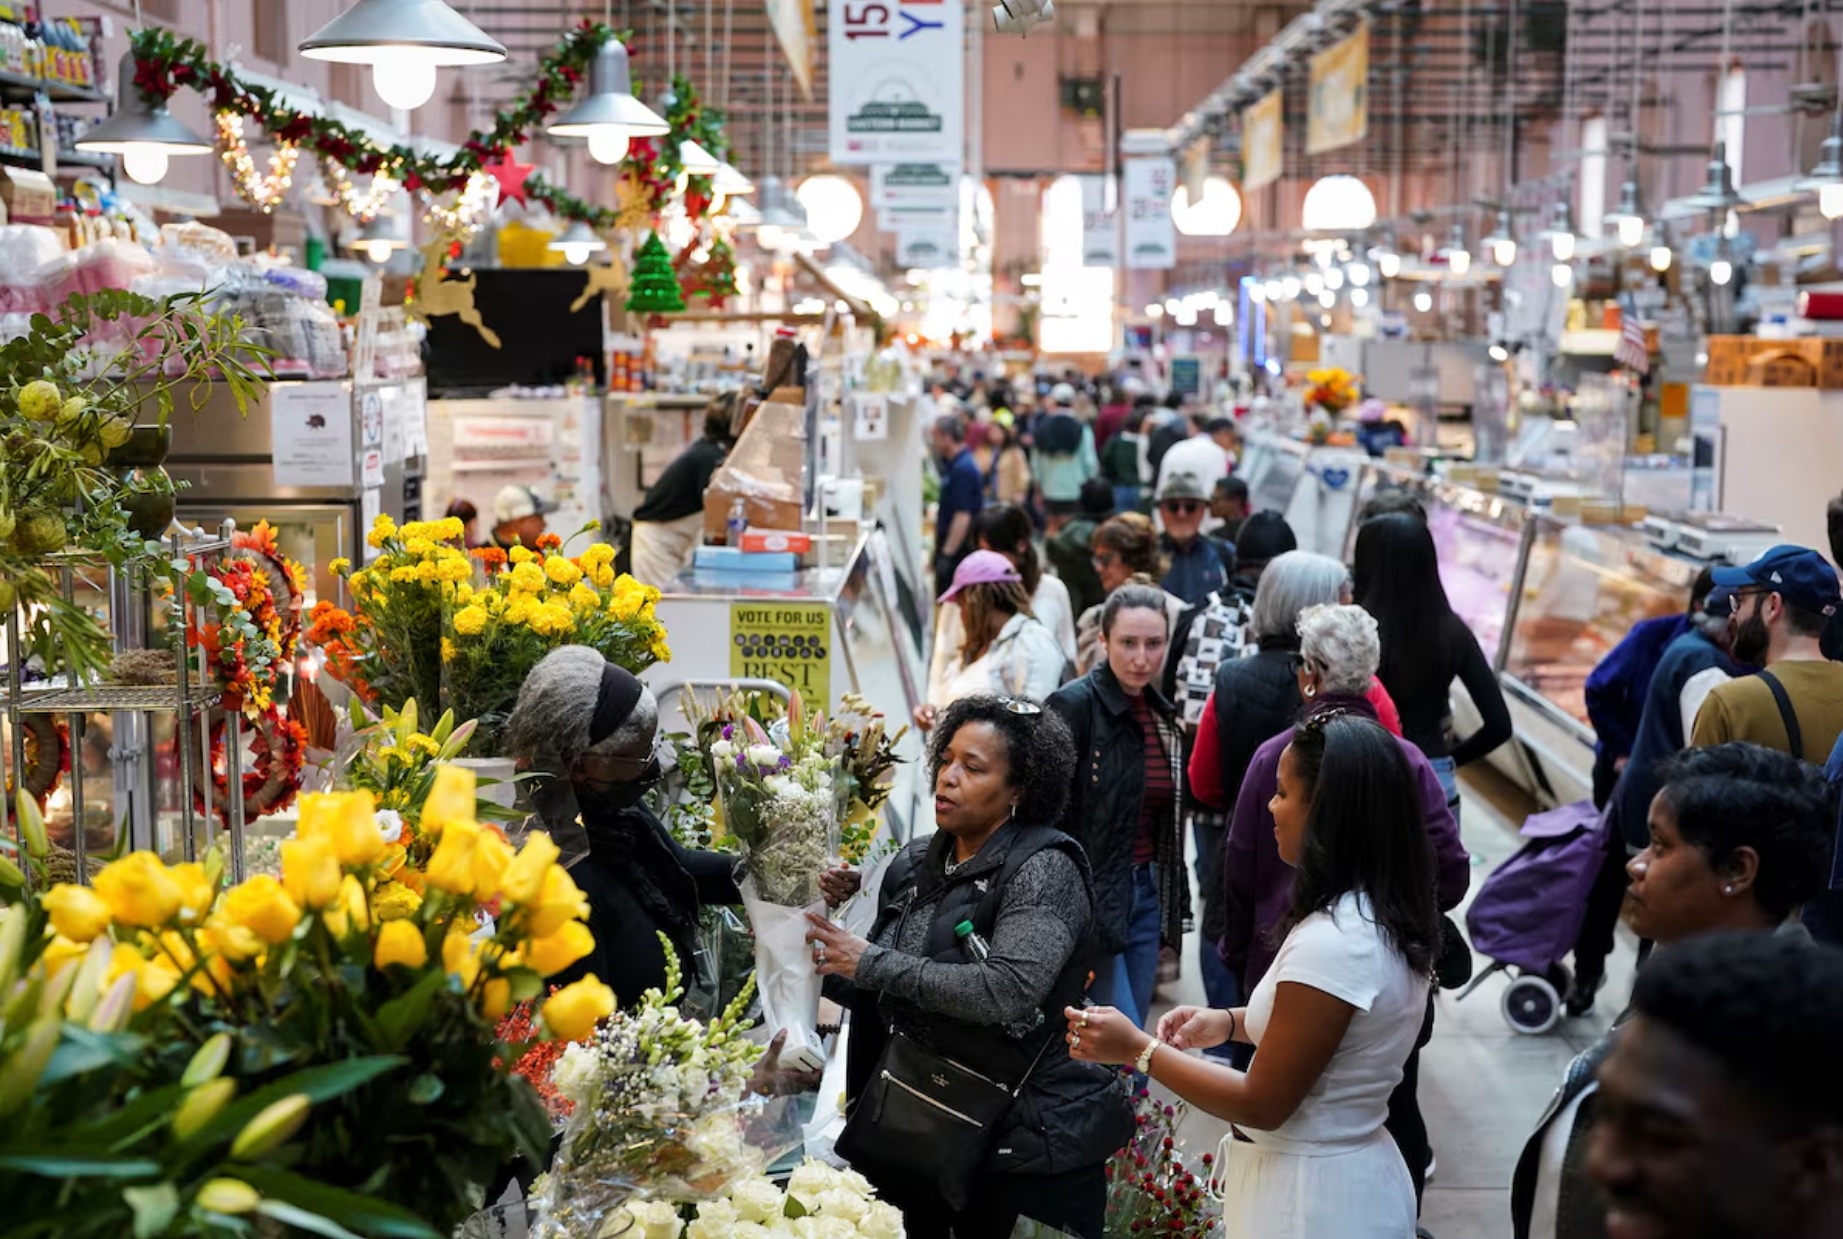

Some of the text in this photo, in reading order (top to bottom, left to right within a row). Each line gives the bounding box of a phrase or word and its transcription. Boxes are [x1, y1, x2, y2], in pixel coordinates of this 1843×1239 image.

[736, 611, 824, 625] VOTE FOR US
